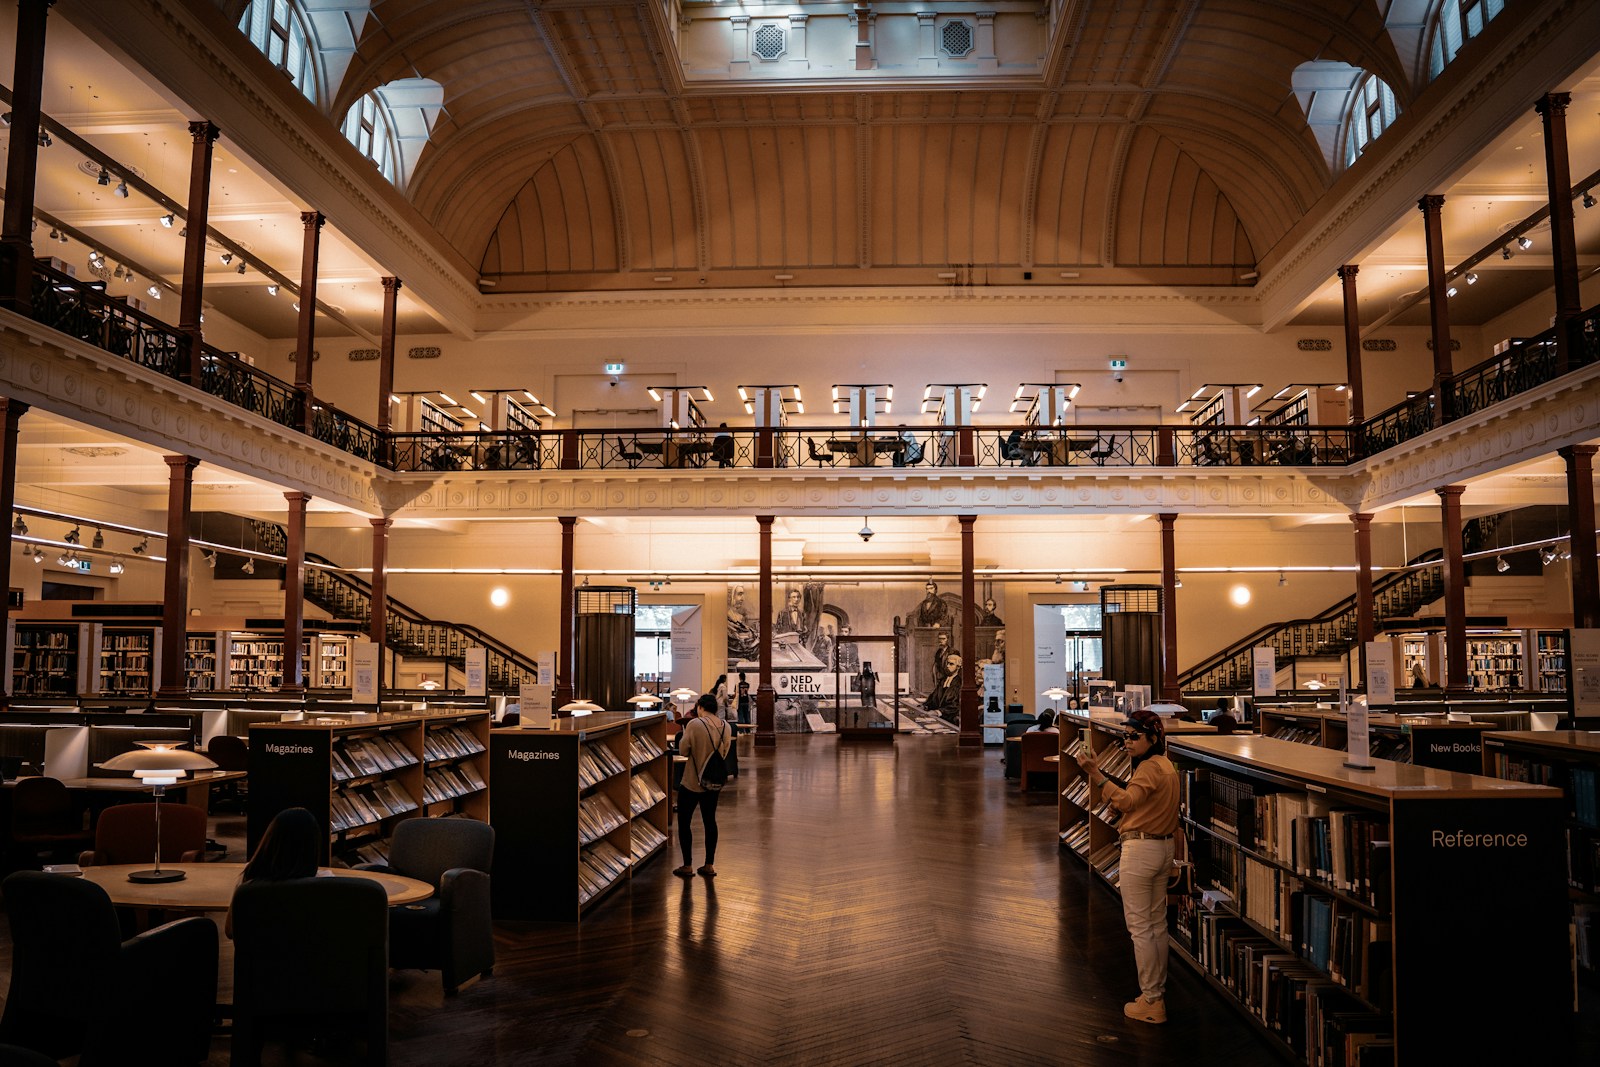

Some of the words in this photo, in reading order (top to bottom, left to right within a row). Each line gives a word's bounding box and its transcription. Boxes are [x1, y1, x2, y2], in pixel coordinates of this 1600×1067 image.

[790, 675, 813, 684] NED
[790, 684, 821, 693] KELLY
[265, 743, 314, 756] Magazines
[1430, 743, 1451, 753] New
[1453, 743, 1481, 753] Books
[508, 749, 560, 762] Magazines
[1432, 829, 1528, 847] Reference
